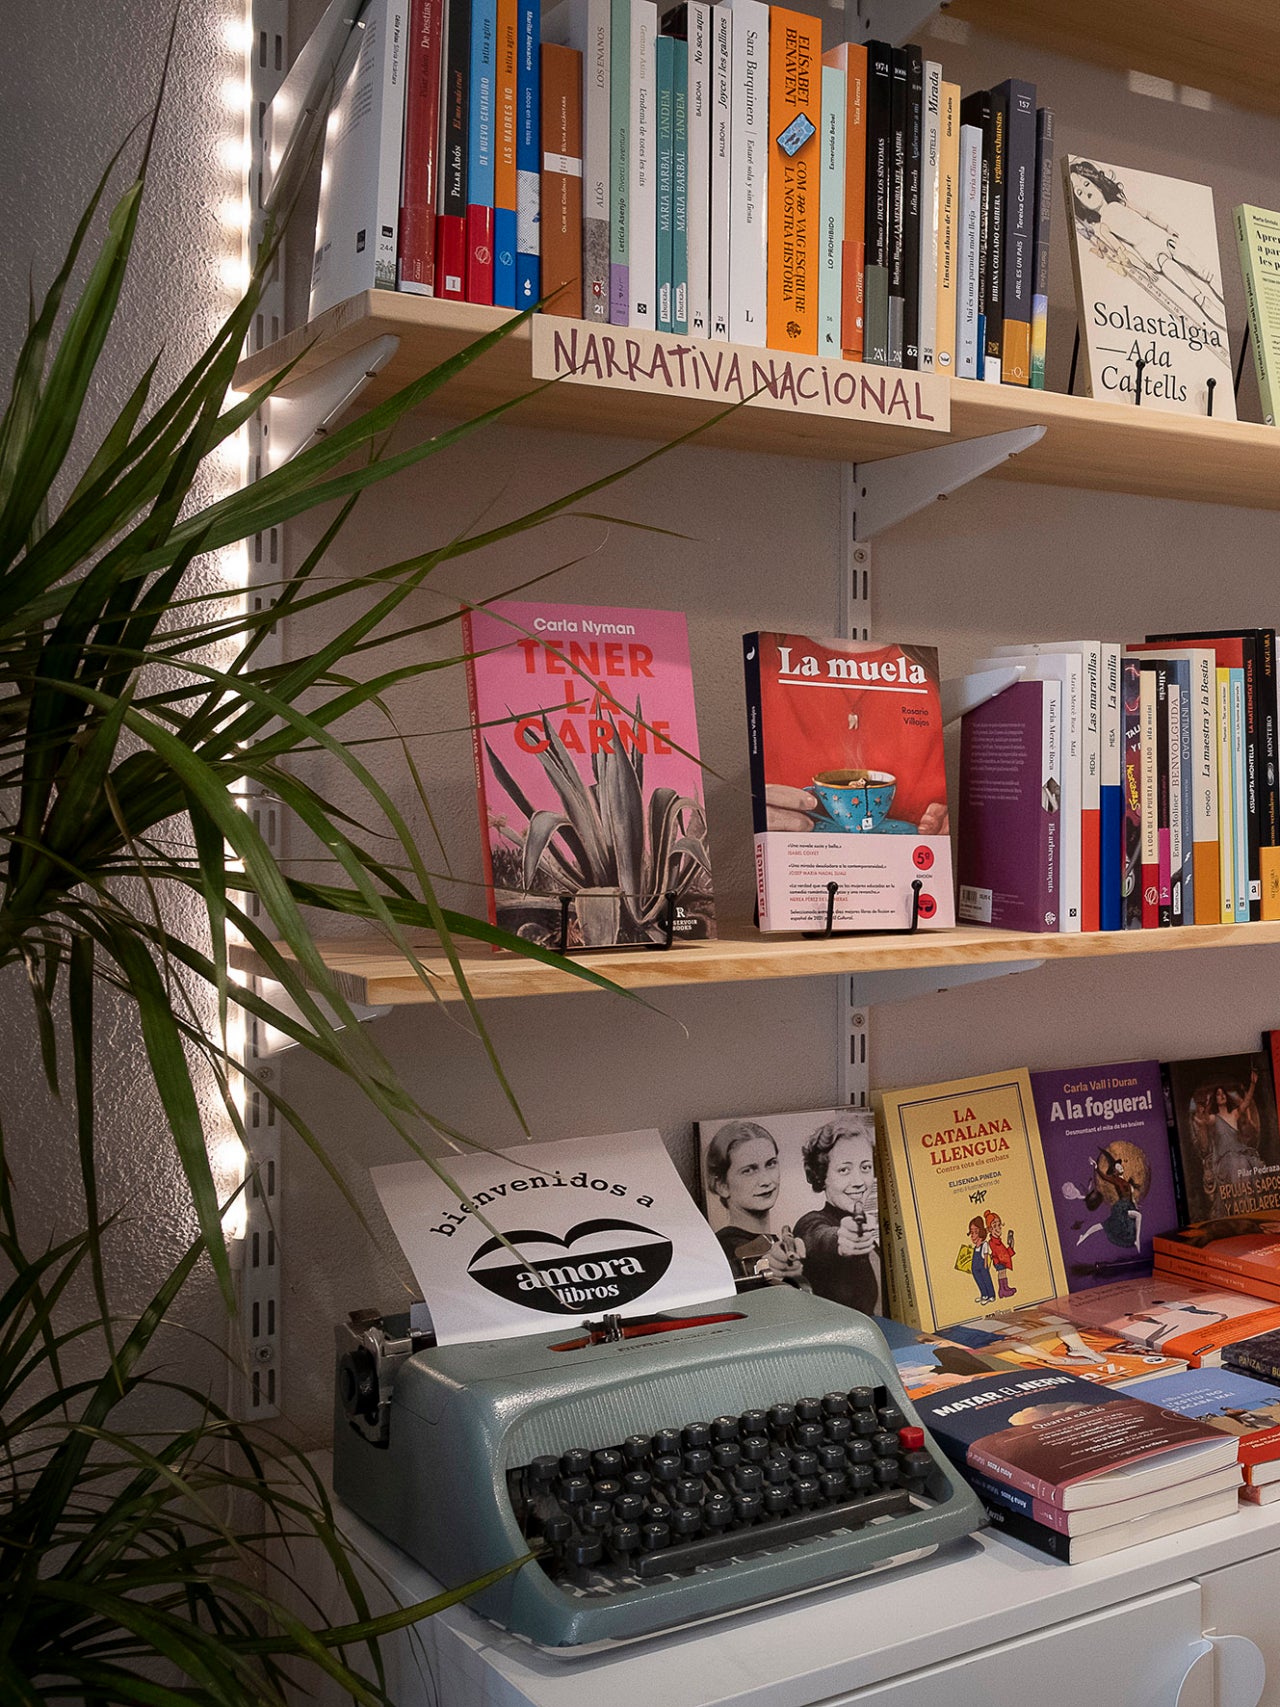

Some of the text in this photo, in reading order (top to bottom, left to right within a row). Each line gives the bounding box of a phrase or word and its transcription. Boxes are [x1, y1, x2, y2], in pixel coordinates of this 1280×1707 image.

[718, 17, 728, 109] Joyce gallines
[744, 30, 758, 126] Sara Barquinero
[785, 28, 798, 107] BENAVENT
[798, 35, 810, 106] ELÍSABET
[480, 77, 490, 166] DE NUEVO CENTAURO
[928, 71, 939, 167] CASTELLS Mirada
[1018, 100, 1030, 109] 157
[504, 87, 513, 165] LAS MADRES NO
[661, 149, 670, 193] BARBAL
[676, 150, 685, 232] MARIA BARBAL
[784, 166, 795, 238] LA NOSTRA
[660, 194, 670, 231] MARIA
[795, 161, 807, 314] COM VAIG ESCRIURE
[1259, 256, 1272, 267] les
[594, 304, 604, 315] 21
[1093, 302, 1223, 352] Solastàlgia
[1126, 339, 1173, 368] Ada
[1101, 366, 1188, 402] Castells
[534, 618, 636, 636] Carla Nyman
[517, 639, 655, 678] TENER
[777, 646, 928, 685] La muela
[1107, 654, 1118, 693] familia
[563, 679, 622, 715] LA
[1087, 652, 1098, 711] maravillas
[901, 706, 929, 716] Rosario
[1107, 695, 1117, 710] La
[1199, 659, 1210, 778] La maestra Bestia
[513, 717, 672, 756] CARNE
[1088, 711, 1097, 733] Las
[1181, 690, 1190, 761] LA INTIMIDAD
[1266, 715, 1274, 757] MONTERO
[1171, 698, 1181, 858] Empar BENVOLGUDA
[755, 843, 765, 895] muela
[1063, 1077, 1138, 1094] Carla Vall Duran
[953, 1108, 977, 1124] LA
[1050, 1090, 1153, 1122] A la foguera!
[921, 1118, 1013, 1149] CATALANA
[1065, 1126, 1096, 1137] Desmuntant
[930, 1137, 1011, 1166] LLENGUA
[935, 1164, 960, 1175] Contra
[960, 1161, 976, 1171] tots
[948, 1170, 1002, 1188] ELISENDA PINEDA
[1237, 1163, 1280, 1178] Pilar Pedraza
[429, 1170, 655, 1238] bienvenidos a
[1224, 1202, 1232, 1215] Y
[516, 1256, 647, 1291] amora
[557, 1282, 620, 1304] libros
[1238, 1355, 1262, 1371] PANZA
[932, 1376, 1077, 1418] MATAR EL NERVI
[1214, 1391, 1236, 1401] MAI
[1031, 1406, 1106, 1431] Quarta edició
